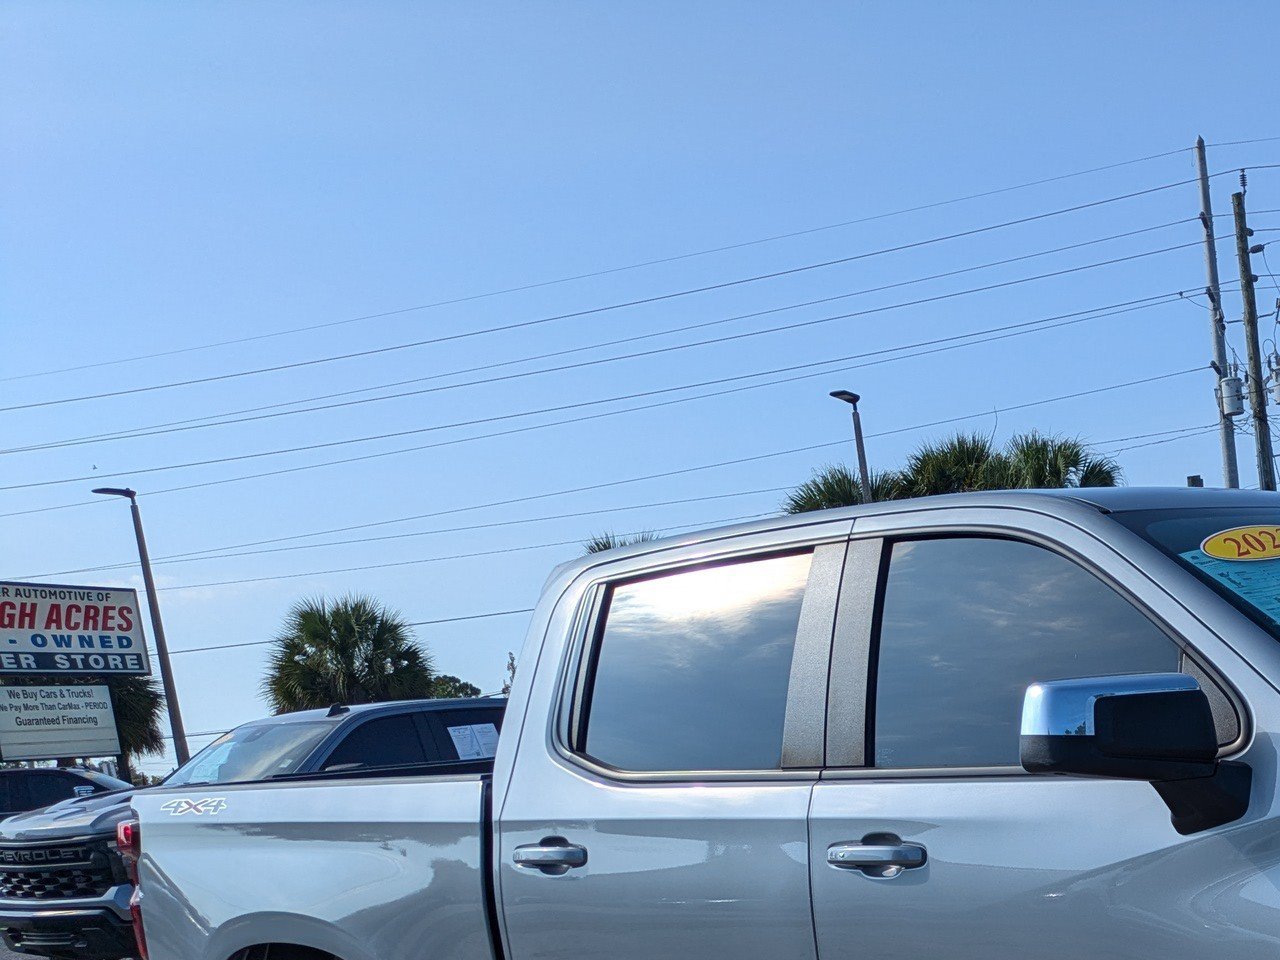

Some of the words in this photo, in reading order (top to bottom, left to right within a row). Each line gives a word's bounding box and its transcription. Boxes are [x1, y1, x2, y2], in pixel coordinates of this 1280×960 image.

[14, 588, 93, 602] AUTOMOTIVE
[96, 593, 112, 602] OF
[44, 603, 133, 632] ACRES
[30, 633, 133, 649] OWNED
[54, 654, 140, 670] STORE
[7, 689, 20, 699] We
[22, 689, 38, 701] Buy
[39, 689, 58, 699] Cars
[59, 689, 66, 699] &
[66, 688, 95, 699] Trucks!
[9, 703, 22, 713] Pay
[22, 703, 40, 711] More
[57, 702, 81, 710] CarMax
[84, 701, 108, 710] PERIOD
[14, 716, 61, 726] Guaranteed
[61, 715, 99, 726] Financing
